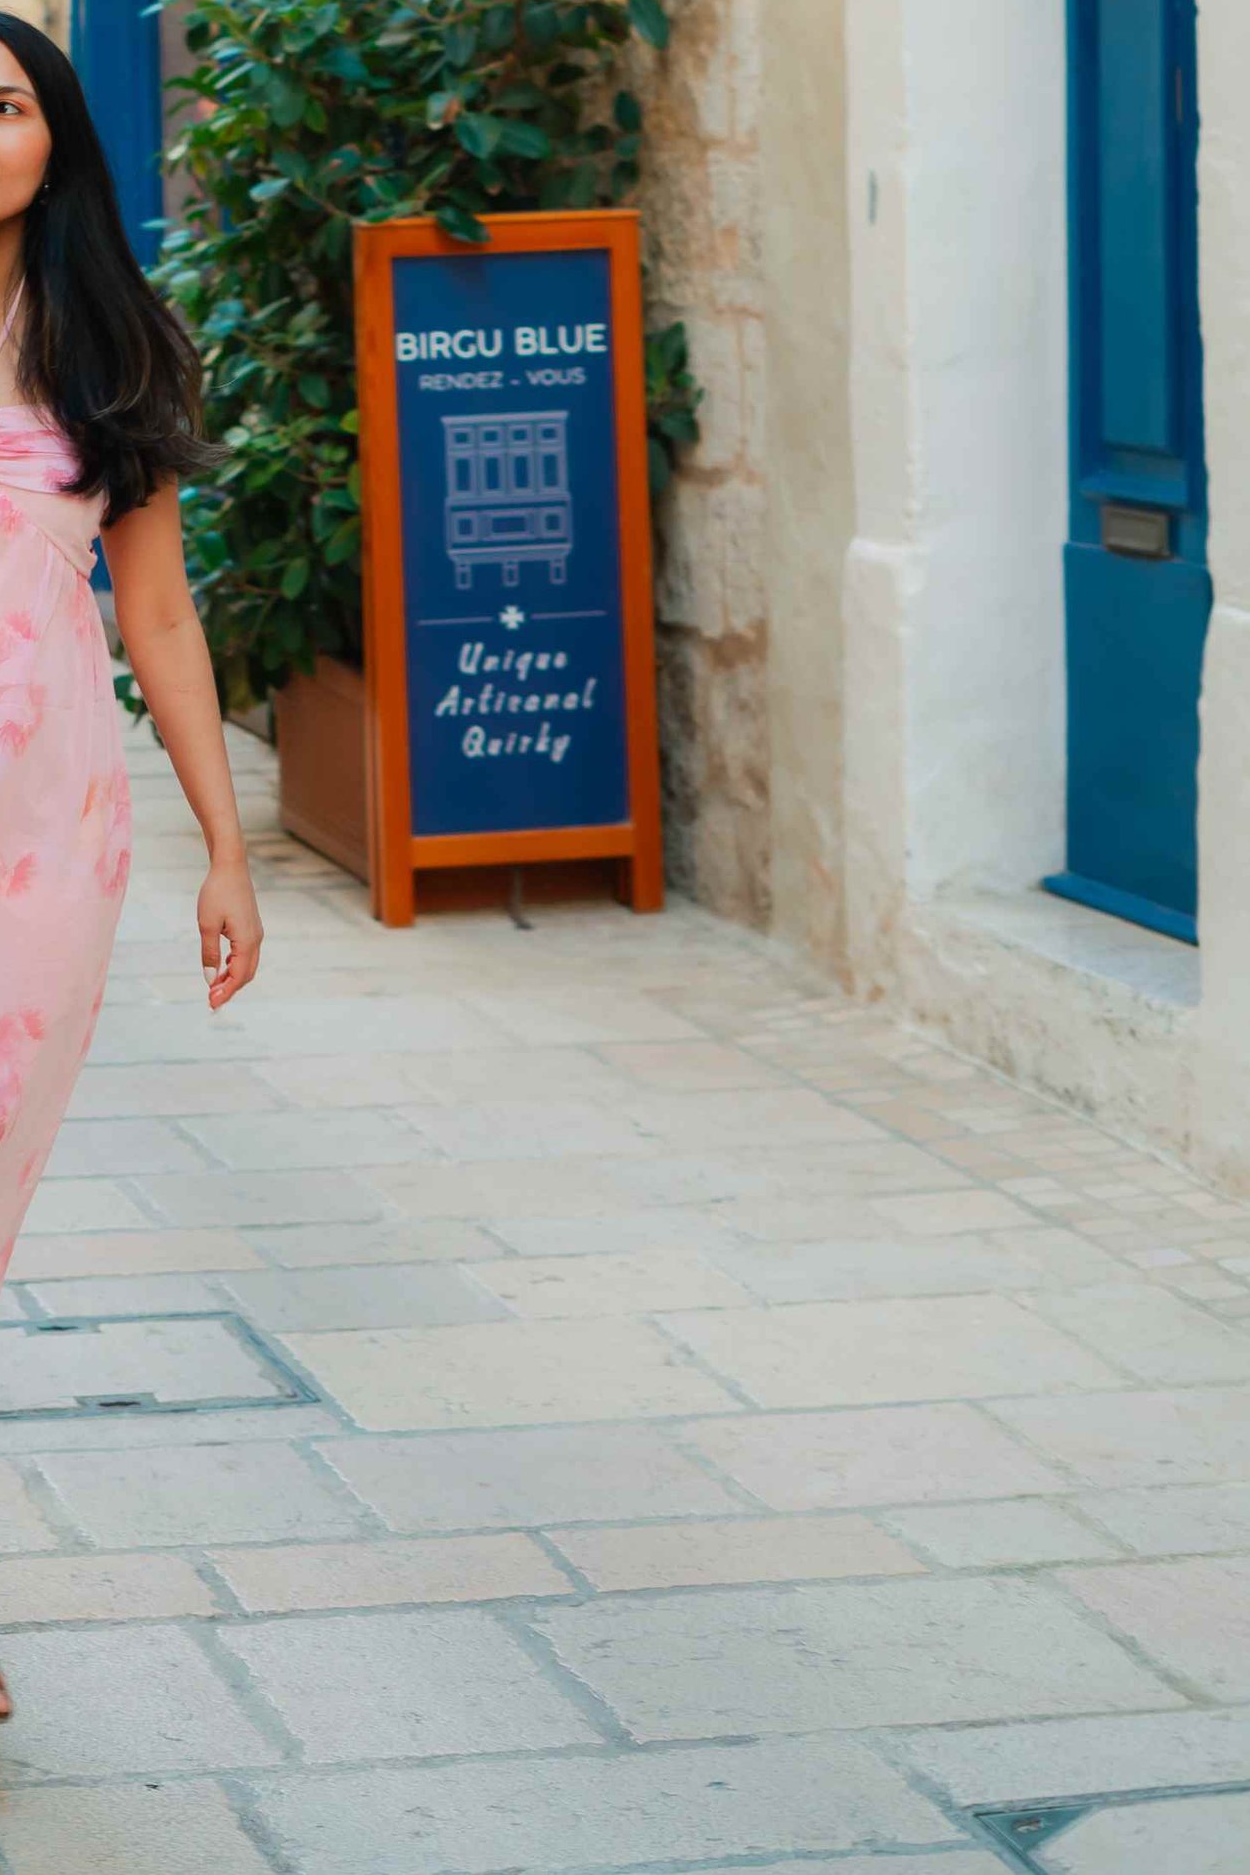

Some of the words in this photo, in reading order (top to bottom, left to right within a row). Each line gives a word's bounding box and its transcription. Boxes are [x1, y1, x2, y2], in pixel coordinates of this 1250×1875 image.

[395, 328, 502, 362] BIRGU
[514, 322, 608, 356] BLUE
[419, 371, 504, 391] RENDEZ
[525, 366, 587, 386] VOUS
[458, 641, 568, 681] Unique
[434, 676, 598, 717] Artisanal
[462, 721, 572, 763] Quirky
